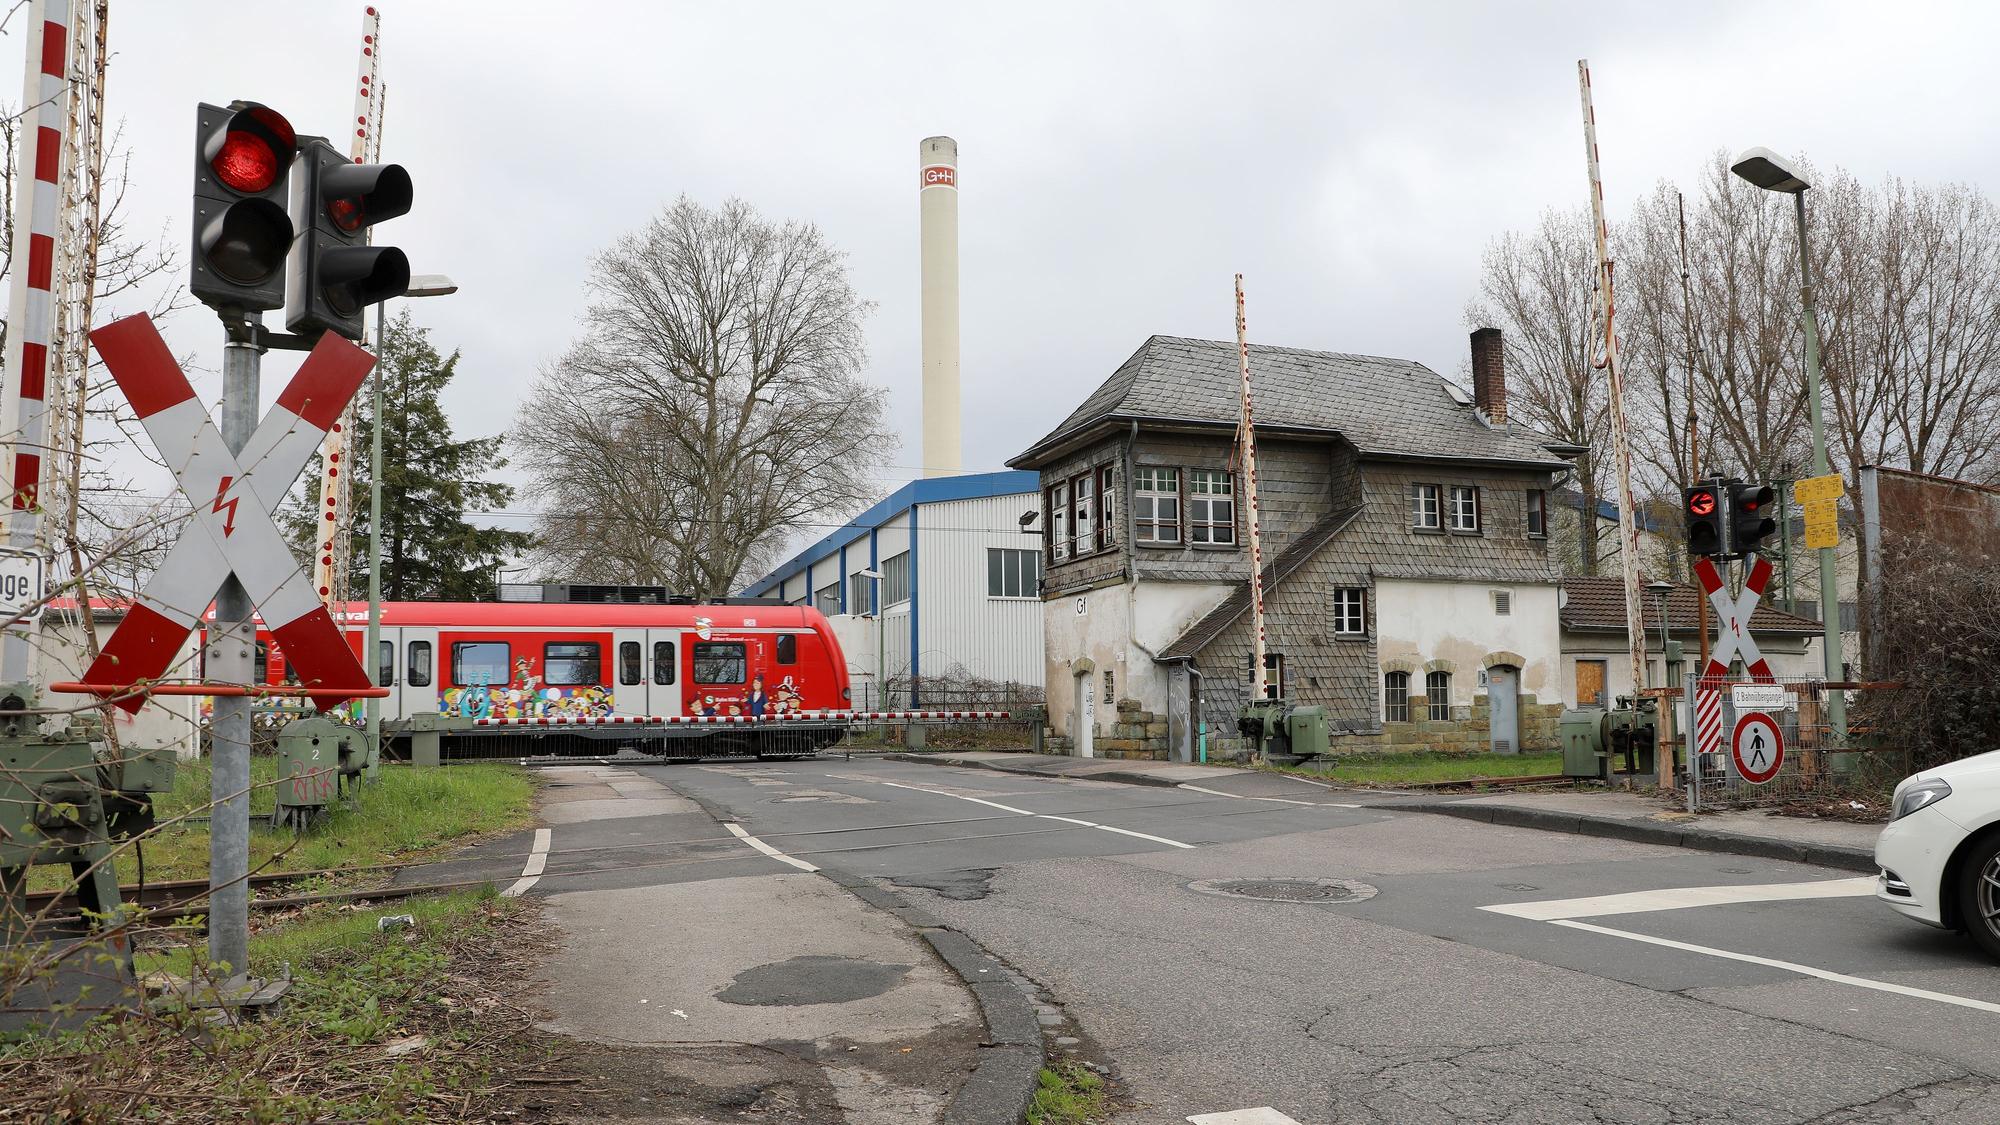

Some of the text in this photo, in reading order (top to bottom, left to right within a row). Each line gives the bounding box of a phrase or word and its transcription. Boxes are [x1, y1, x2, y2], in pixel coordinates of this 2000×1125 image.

[926, 169, 953, 184] G+H
[0, 574, 28, 601] ge
[1076, 596, 1087, 614] Gf
[756, 642, 763, 655] 1
[1736, 691, 1741, 702] 2
[312, 749, 320, 760] 2
